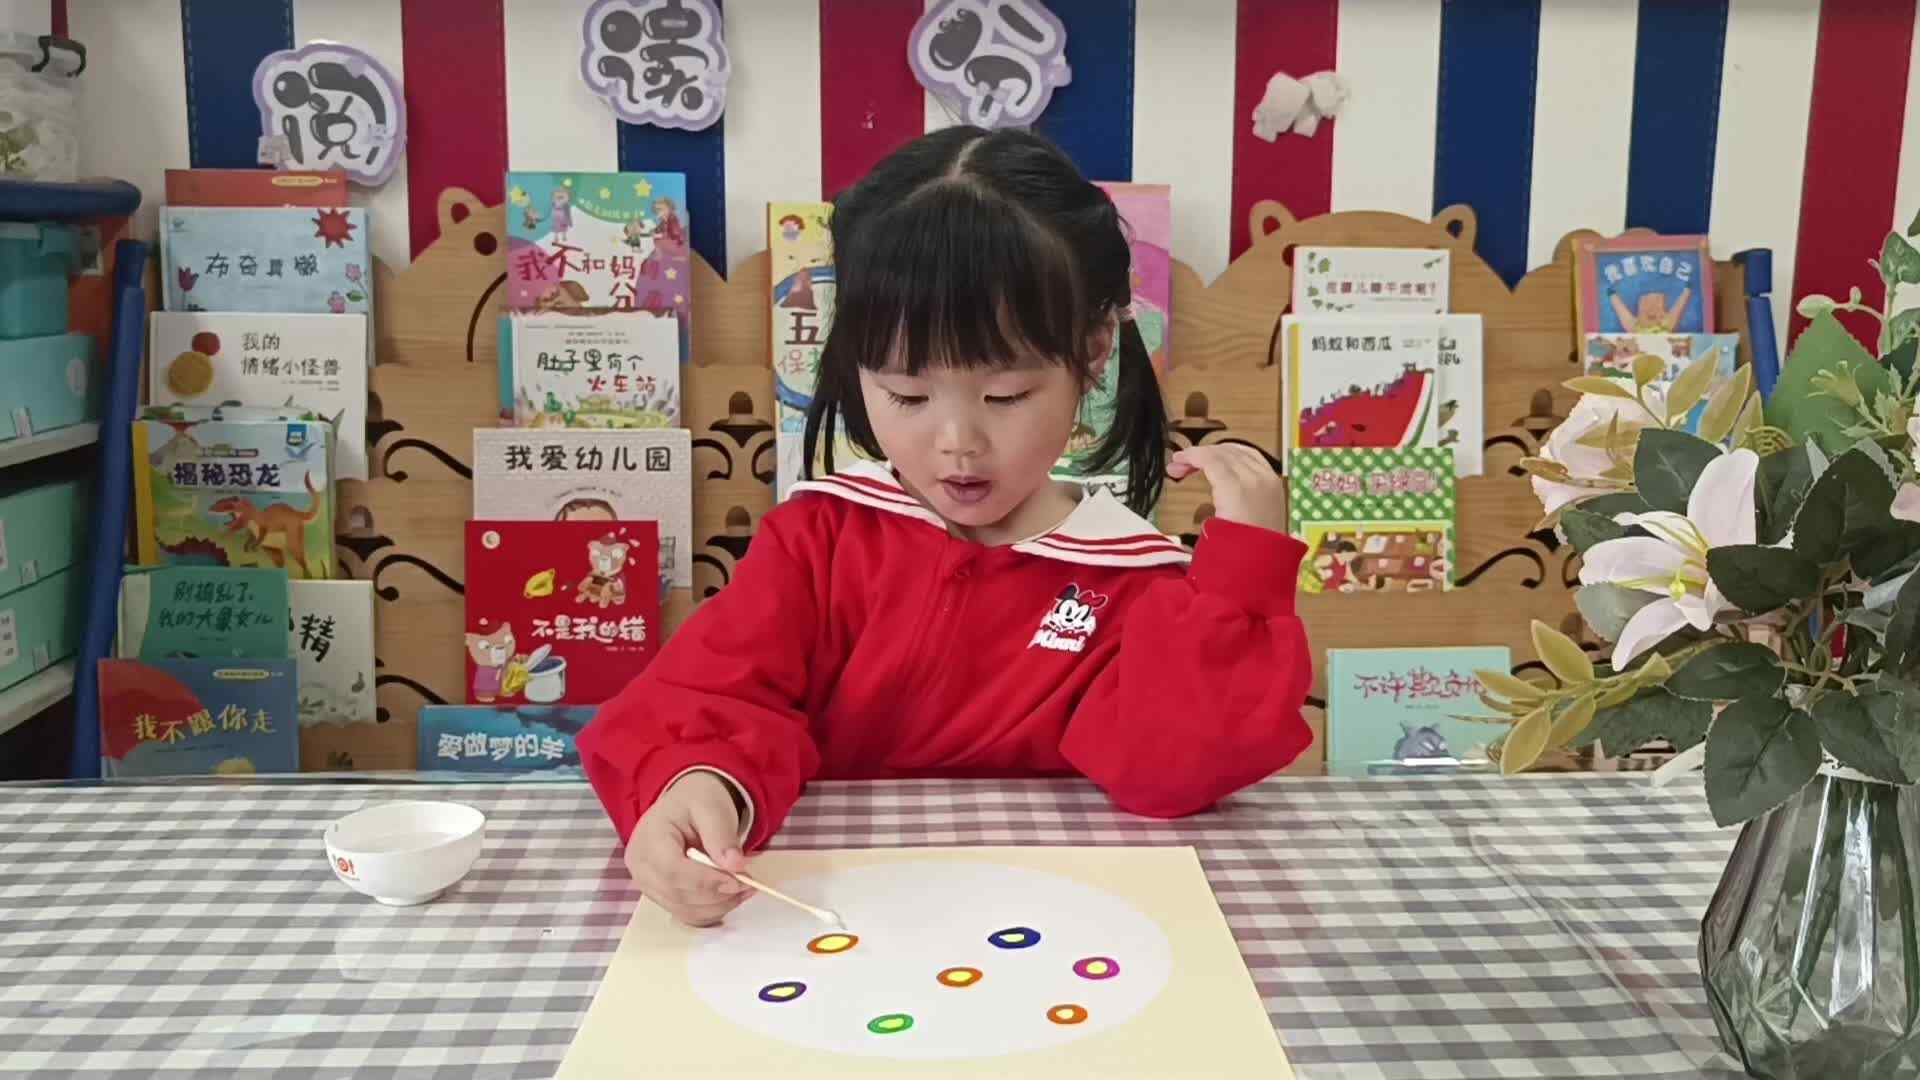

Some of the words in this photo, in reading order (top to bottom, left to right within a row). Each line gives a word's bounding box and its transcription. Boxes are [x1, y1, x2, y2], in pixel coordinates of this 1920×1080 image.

[598, 0, 708, 110] 读
[273, 61, 387, 165] 阅
[785, 312, 825, 344] 五
[241, 332, 281, 351] 我的
[1311, 336, 1393, 352] 蚂蚁和西瓜
[241, 358, 342, 377] 情绪小怪兽
[537, 349, 644, 372] 肚子里有个
[588, 375, 657, 397] 火车站
[505, 445, 671, 471] 我爱幼儿园
[173, 462, 280, 487] 揭秘恐龙
[531, 614, 647, 644] 不是我的错
[131, 703, 277, 744] 我不跟你走
[437, 733, 566, 761] 爱做梦的羊
